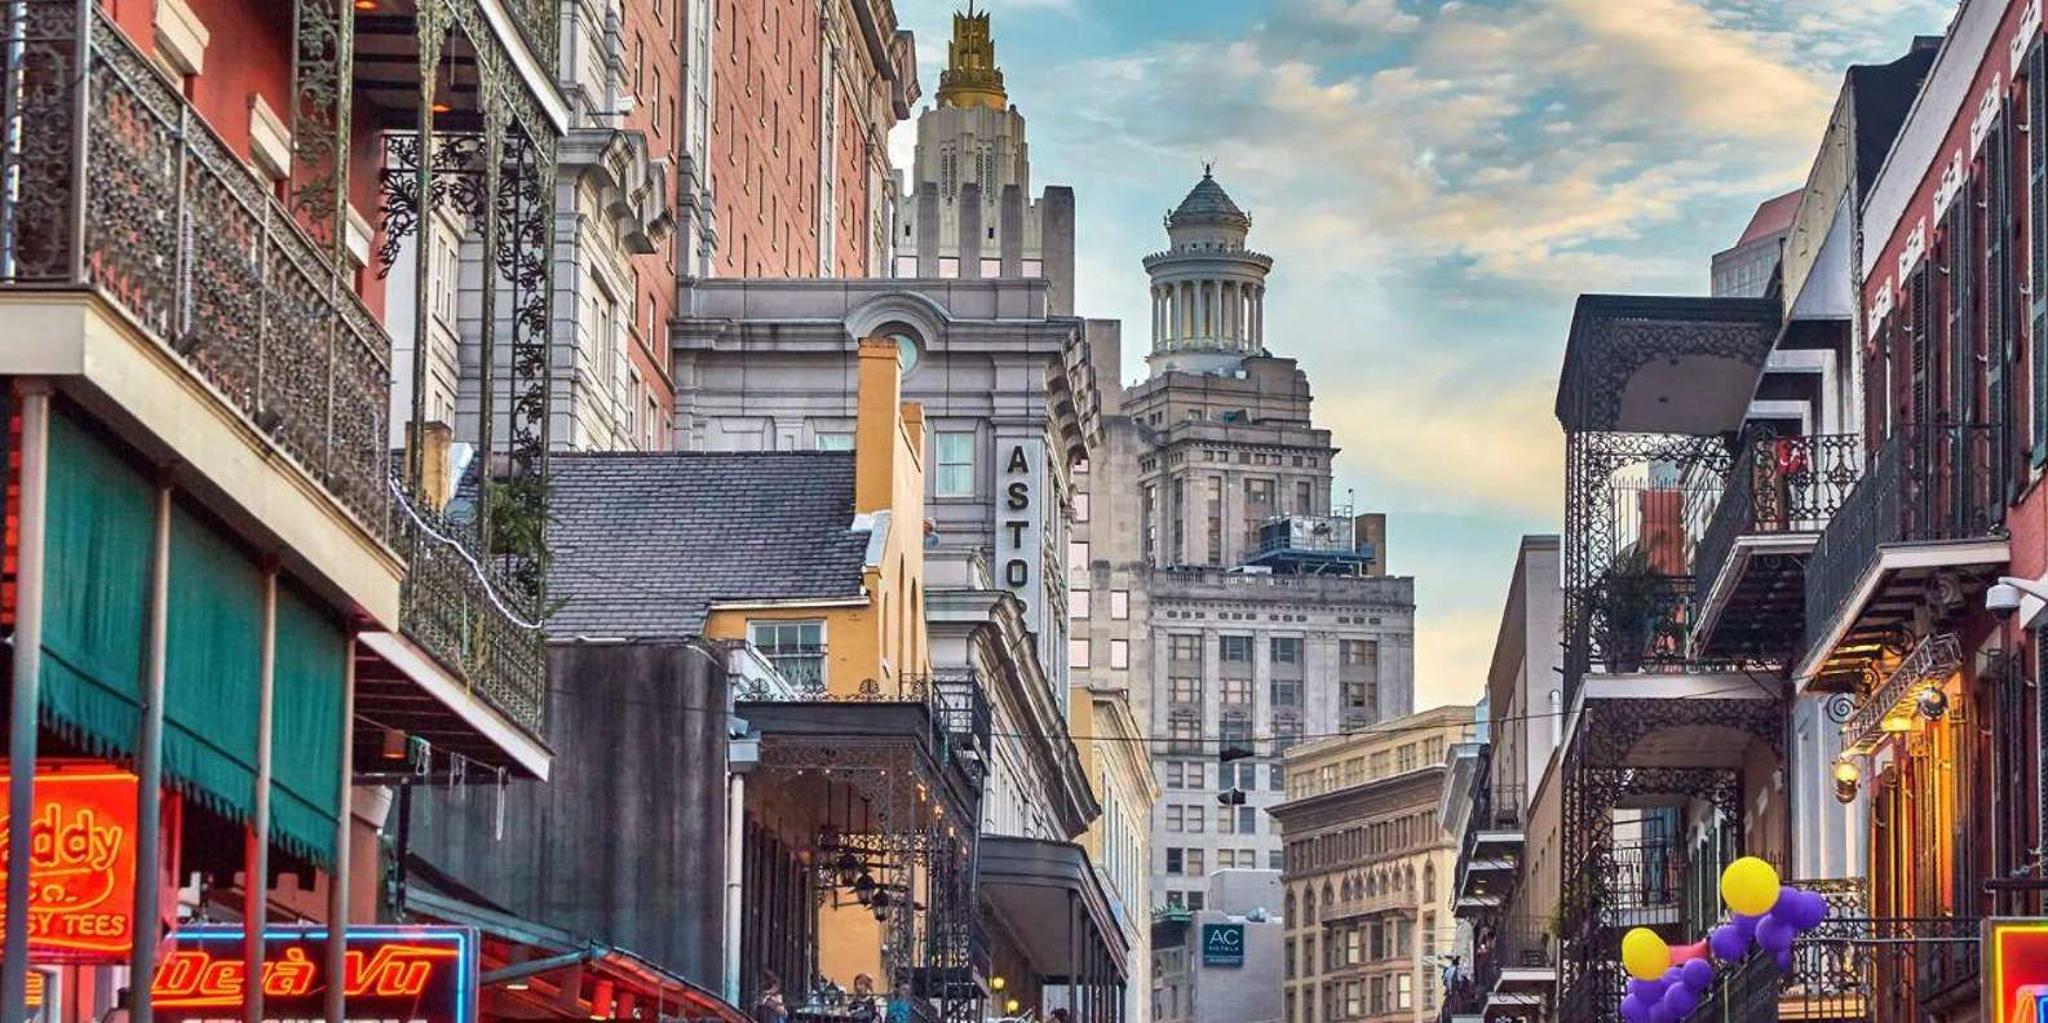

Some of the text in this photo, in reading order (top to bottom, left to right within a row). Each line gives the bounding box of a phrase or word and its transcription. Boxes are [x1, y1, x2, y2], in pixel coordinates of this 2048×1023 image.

[0, 802, 123, 872] ddy
[63, 913, 126, 936] TEES
[1209, 929, 1240, 945] AC
[150, 944, 459, 996] Deà Vu
